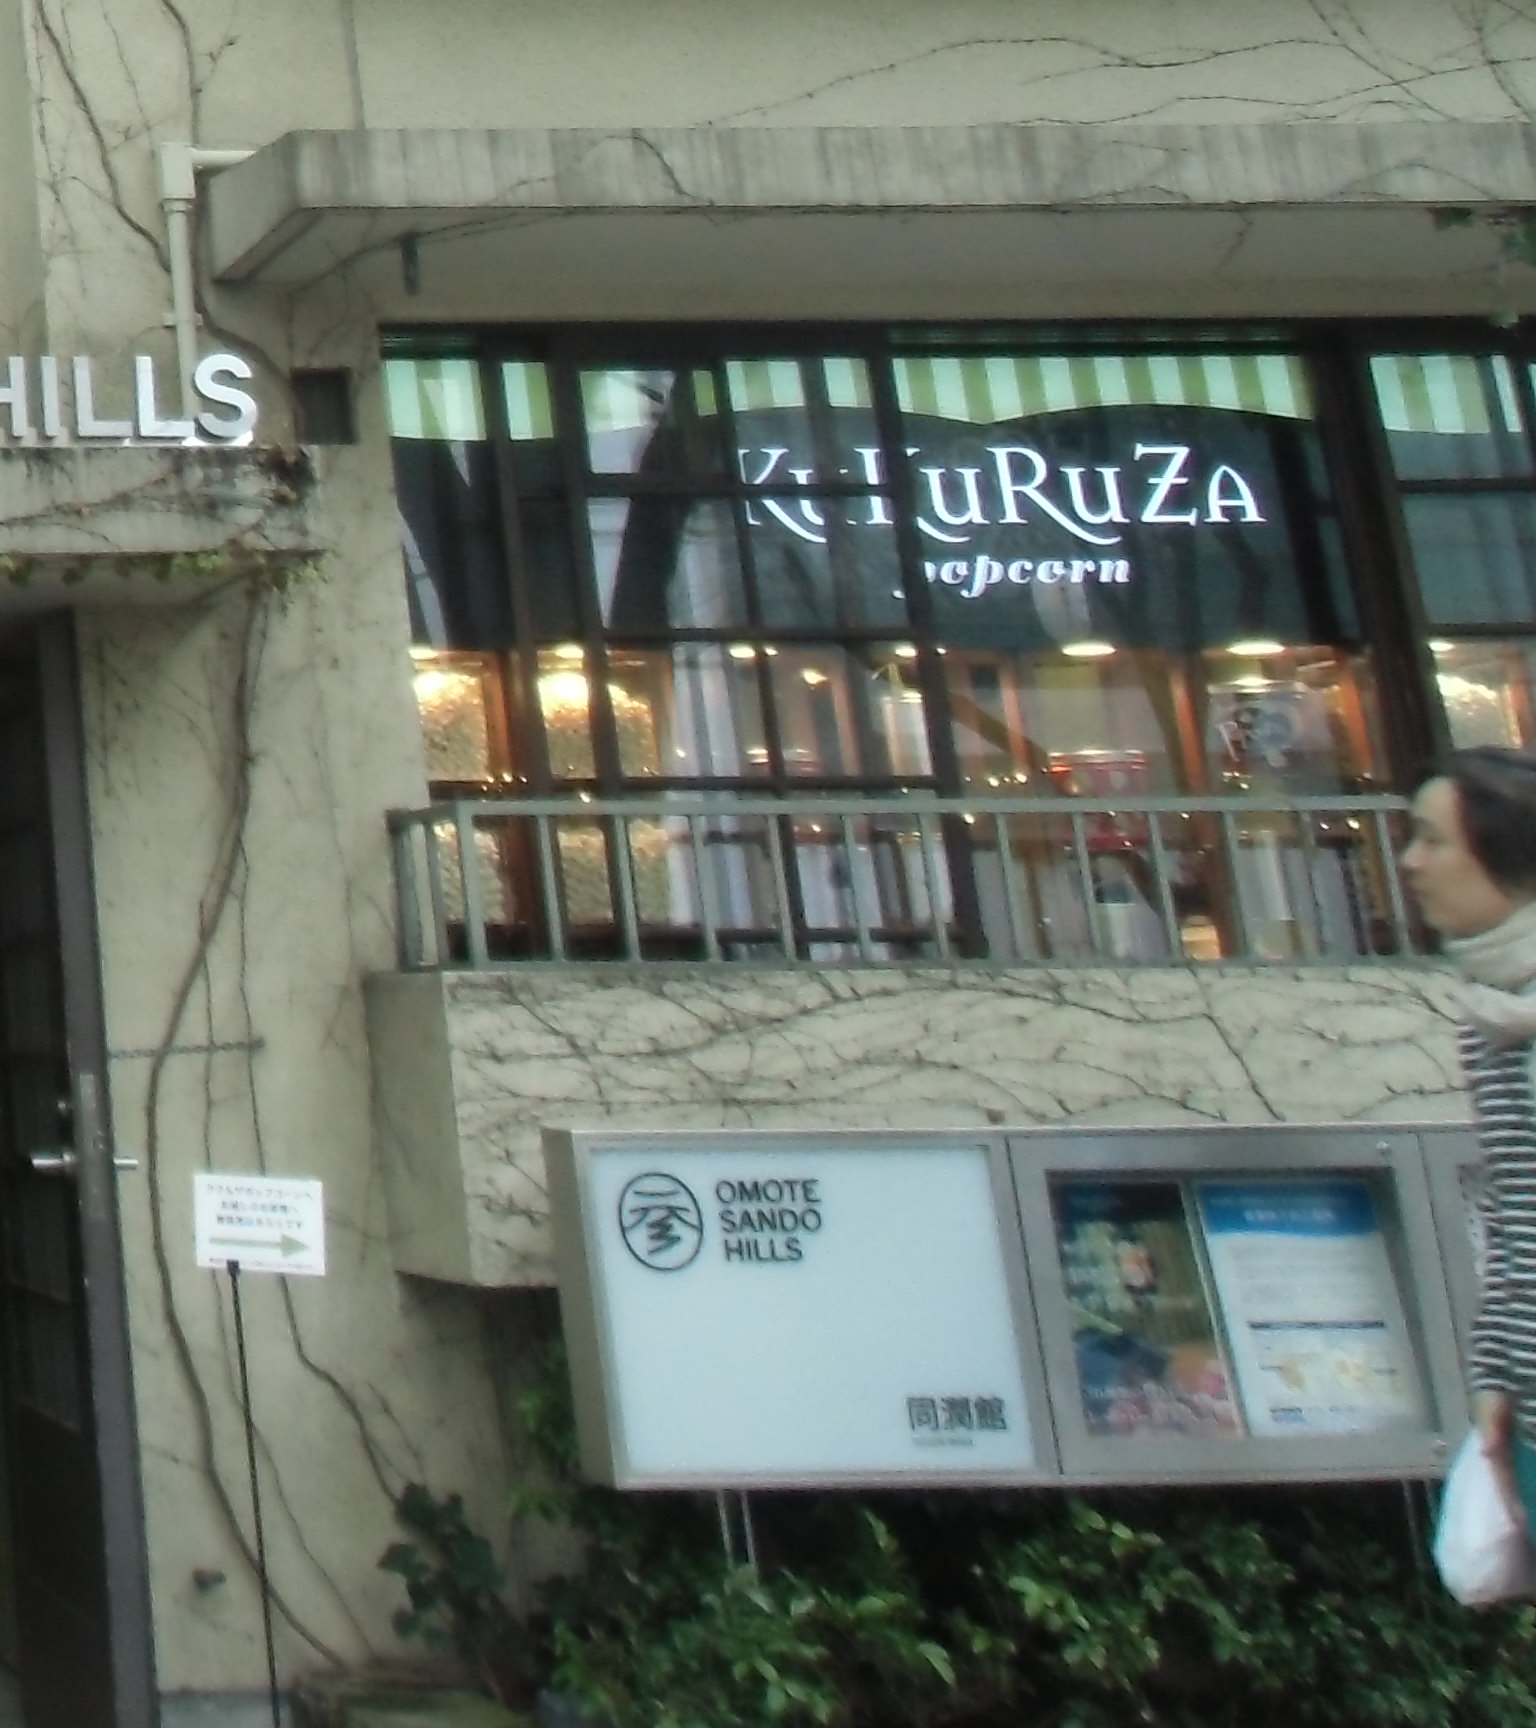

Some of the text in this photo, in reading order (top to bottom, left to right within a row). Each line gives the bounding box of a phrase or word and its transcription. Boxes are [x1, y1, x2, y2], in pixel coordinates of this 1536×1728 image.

[715, 1179, 822, 1204] OMOTE
[718, 1207, 823, 1233] SANDO
[724, 1236, 803, 1262] HILLS
